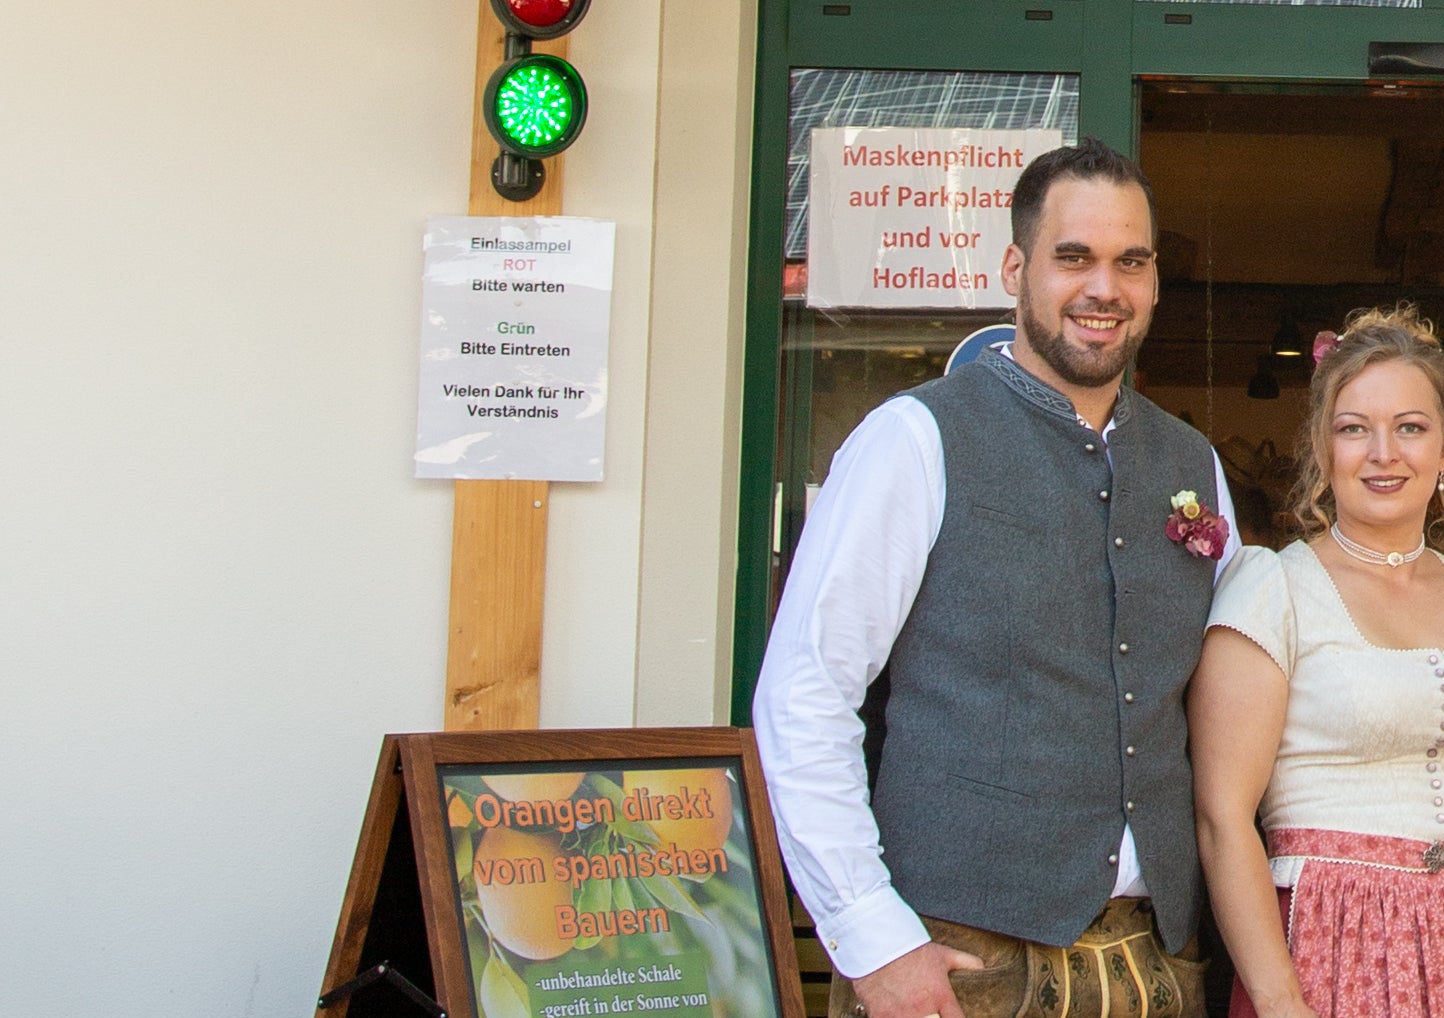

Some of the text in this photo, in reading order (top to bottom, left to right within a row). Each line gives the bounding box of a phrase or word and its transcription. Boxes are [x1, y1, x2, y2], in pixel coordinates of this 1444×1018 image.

[843, 145, 1024, 172] Maskenpflicht
[849, 184, 1014, 212] auf Parkplatz
[471, 237, 571, 254] Einlassampel
[882, 227, 981, 249] und vor
[503, 258, 536, 271] ROT
[472, 279, 565, 293] Bitte warten
[873, 267, 988, 290] Hofladen
[497, 321, 535, 335] Grün
[461, 342, 570, 356] Bitte Eintreten
[443, 384, 585, 399] Vielen Dank für Ihr
[467, 404, 559, 419] Verständnis
[474, 786, 714, 834] Orangen direkt
[474, 843, 729, 889] vom spanischen
[555, 904, 671, 939] Bauern
[535, 964, 682, 991] -unbehandelte Schale
[594, 1001, 608, 1015] in
[612, 997, 634, 1013] der
[637, 994, 679, 1011] Sonne
[682, 992, 708, 1007] von
